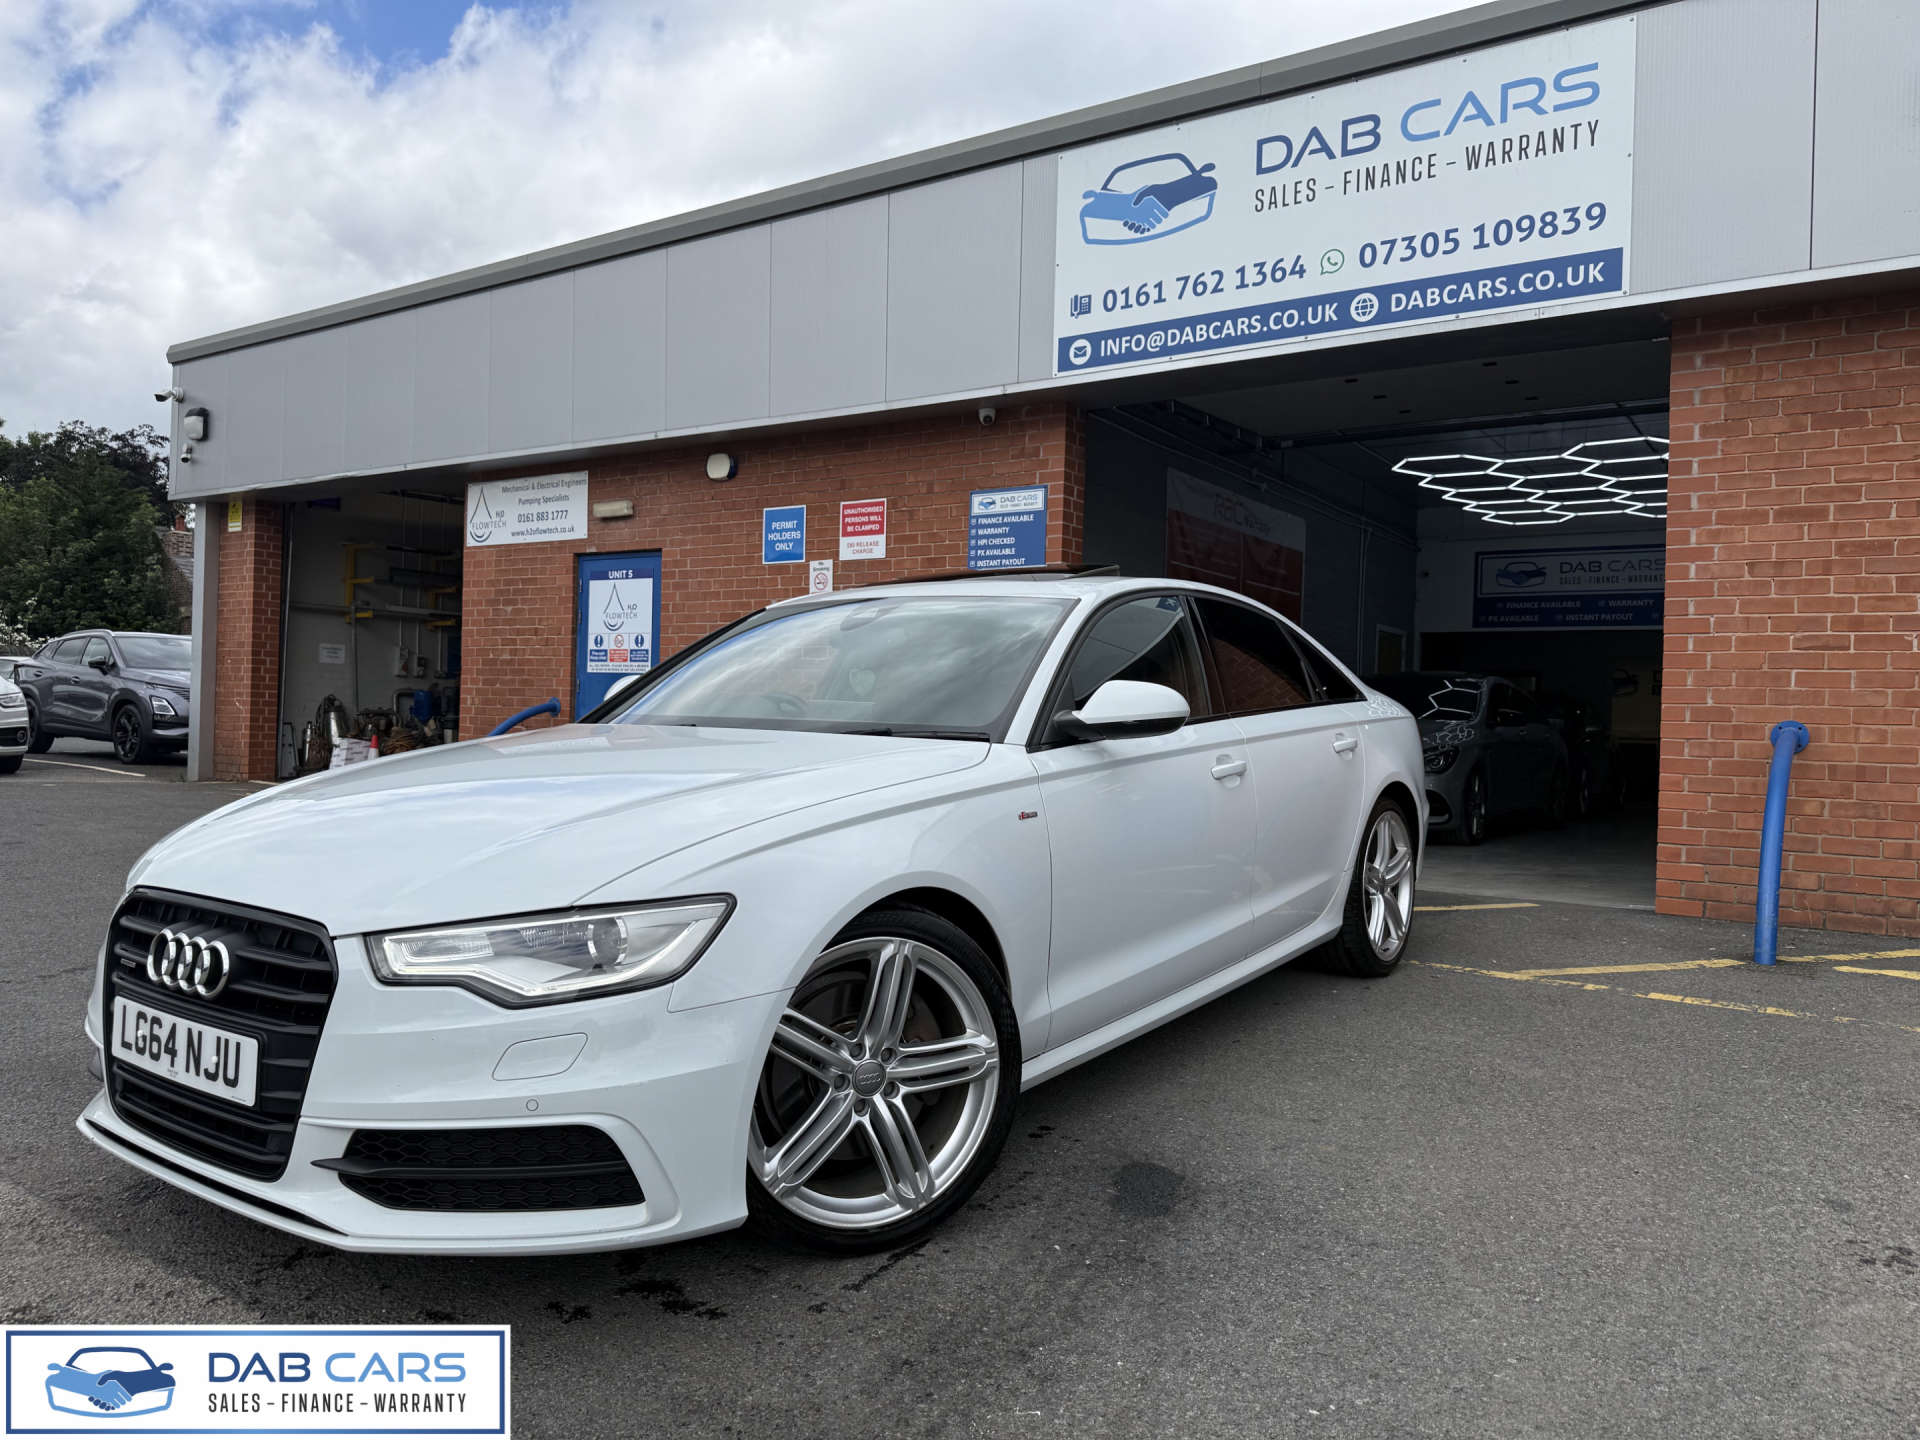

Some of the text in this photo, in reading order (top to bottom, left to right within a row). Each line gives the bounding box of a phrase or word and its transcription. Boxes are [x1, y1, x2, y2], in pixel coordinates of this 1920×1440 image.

[1255, 62, 1600, 176] DAB CARS
[1254, 178, 1317, 213] SALES
[1342, 153, 1437, 196] FINANCE
[1464, 119, 1600, 172] WARRANTY
[1102, 202, 1607, 313] 0161 762 1364 07305 109839
[1099, 261, 1605, 359] INFO@DABCARS.CO.UK DABCARS.CO.UK
[518, 493, 570, 506] Pumping Specialists
[517, 509, 569, 523] 0161 883 1777
[845, 514, 882, 523] PERSONS WILL
[978, 513, 1035, 525] FINANCE AVAILABLE
[472, 520, 507, 530] FLOWTECH
[771, 520, 798, 530] PERMIT
[768, 530, 801, 541] HOLDERS
[978, 527, 1009, 535] WARRANTY
[988, 536, 1016, 545] CHECKED
[775, 542, 794, 551] ONLY
[977, 547, 1016, 557] PX AVAILABLE
[977, 557, 1026, 567] INSTANT PAYOUT
[1560, 560, 1602, 575] DAB
[608, 569, 633, 579] UNIT 5
[1608, 598, 1655, 608] WARRANTY
[605, 611, 638, 620] FLOWTECH
[1565, 612, 1599, 622] INSTANT
[1601, 611, 1633, 621] PAYOUT
[121, 1004, 241, 1088] LG64 NJU
